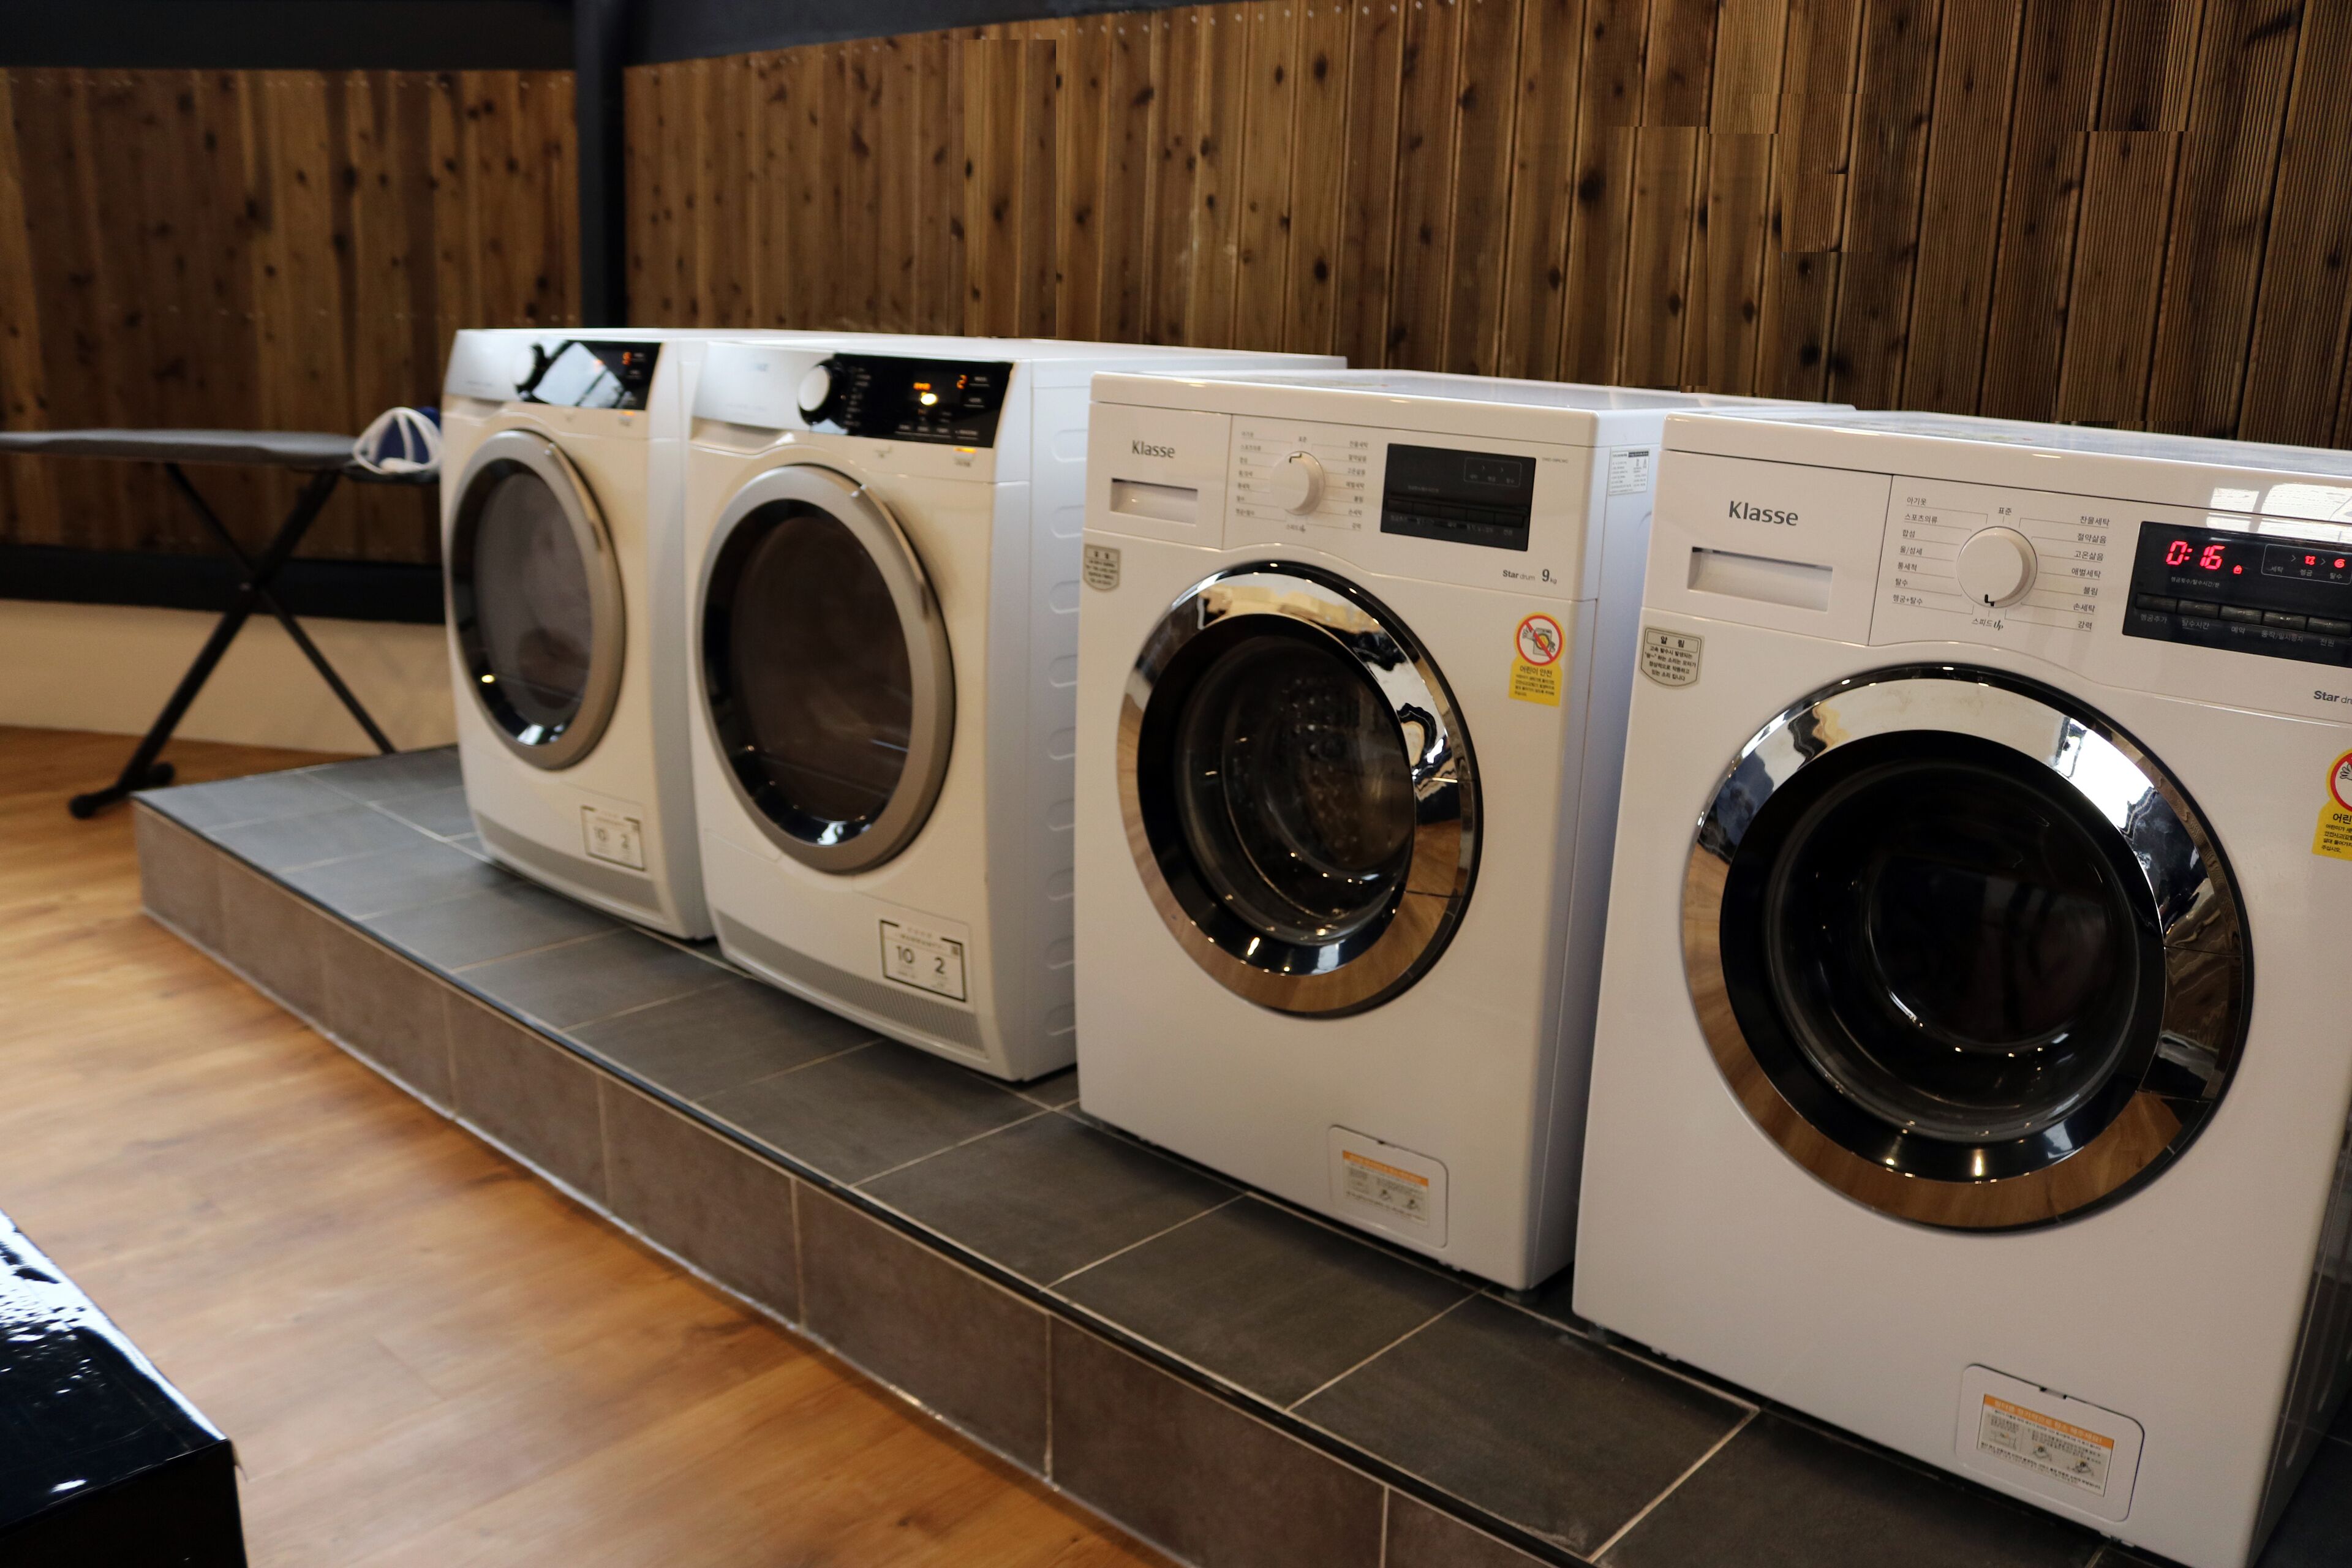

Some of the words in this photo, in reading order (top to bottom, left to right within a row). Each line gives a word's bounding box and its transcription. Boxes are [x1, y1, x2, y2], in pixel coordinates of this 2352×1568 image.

[1131, 440, 1175, 459] Klasse
[1907, 496, 1927, 506] 아기옷
[1728, 500, 1798, 526] Klasse
[1999, 507, 2012, 516] 표준
[1904, 513, 1938, 524] 스포츠의류
[2080, 516, 2110, 527] 찬물세탁
[1902, 529, 1915, 538] 합섬
[2078, 532, 2107, 544] 절약삶음
[1899, 545, 1922, 556] 울/섬세
[2074, 550, 2103, 561] 고온삶음
[2165, 540, 2226, 570] 0:16
[1897, 562, 1917, 572] 통세척
[2071, 567, 2101, 578] 애벌세탁
[1502, 570, 1519, 578] Star
[1895, 578, 1908, 587] 탈수
[2083, 586, 2098, 596] 불림
[2073, 603, 2095, 613] 손세탁
[2077, 620, 2092, 630] 강력
[2313, 690, 2340, 702] Star
[896, 945, 915, 965] 10
[934, 956, 945, 974] 2
